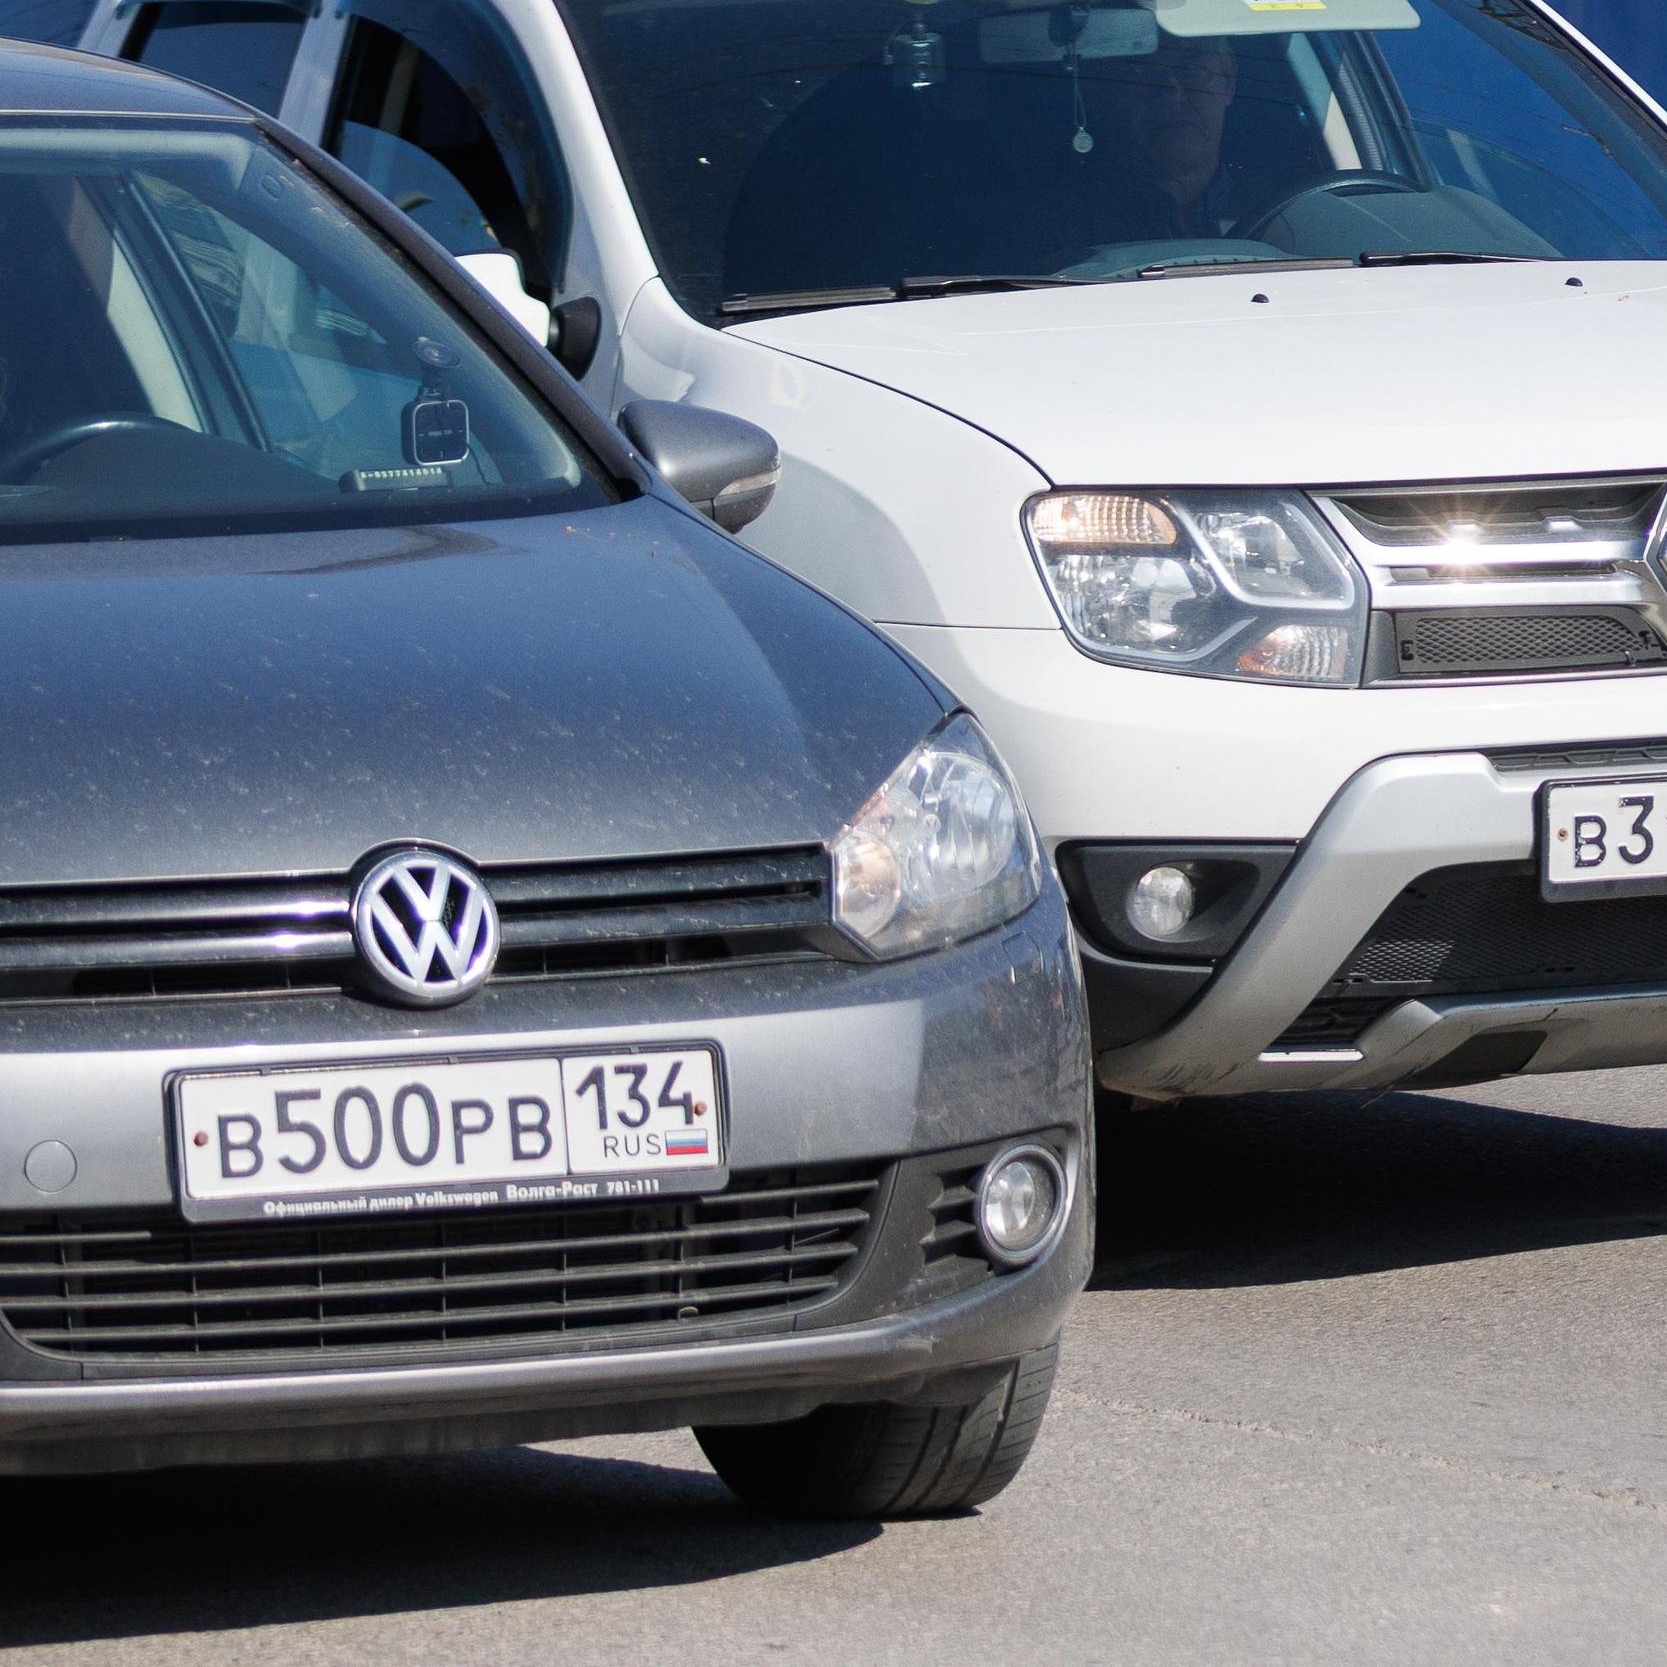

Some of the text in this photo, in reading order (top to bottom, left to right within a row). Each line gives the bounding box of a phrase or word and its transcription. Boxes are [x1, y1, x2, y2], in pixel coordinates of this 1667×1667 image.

[216, 1061, 695, 1180] В500РВ 134
[602, 1133, 662, 1158] RUS
[262, 1197, 368, 1218] Официальный
[369, 1195, 414, 1213] дилер
[415, 1190, 499, 1208] Volkswagen
[505, 1180, 599, 1200] Волга-Раст
